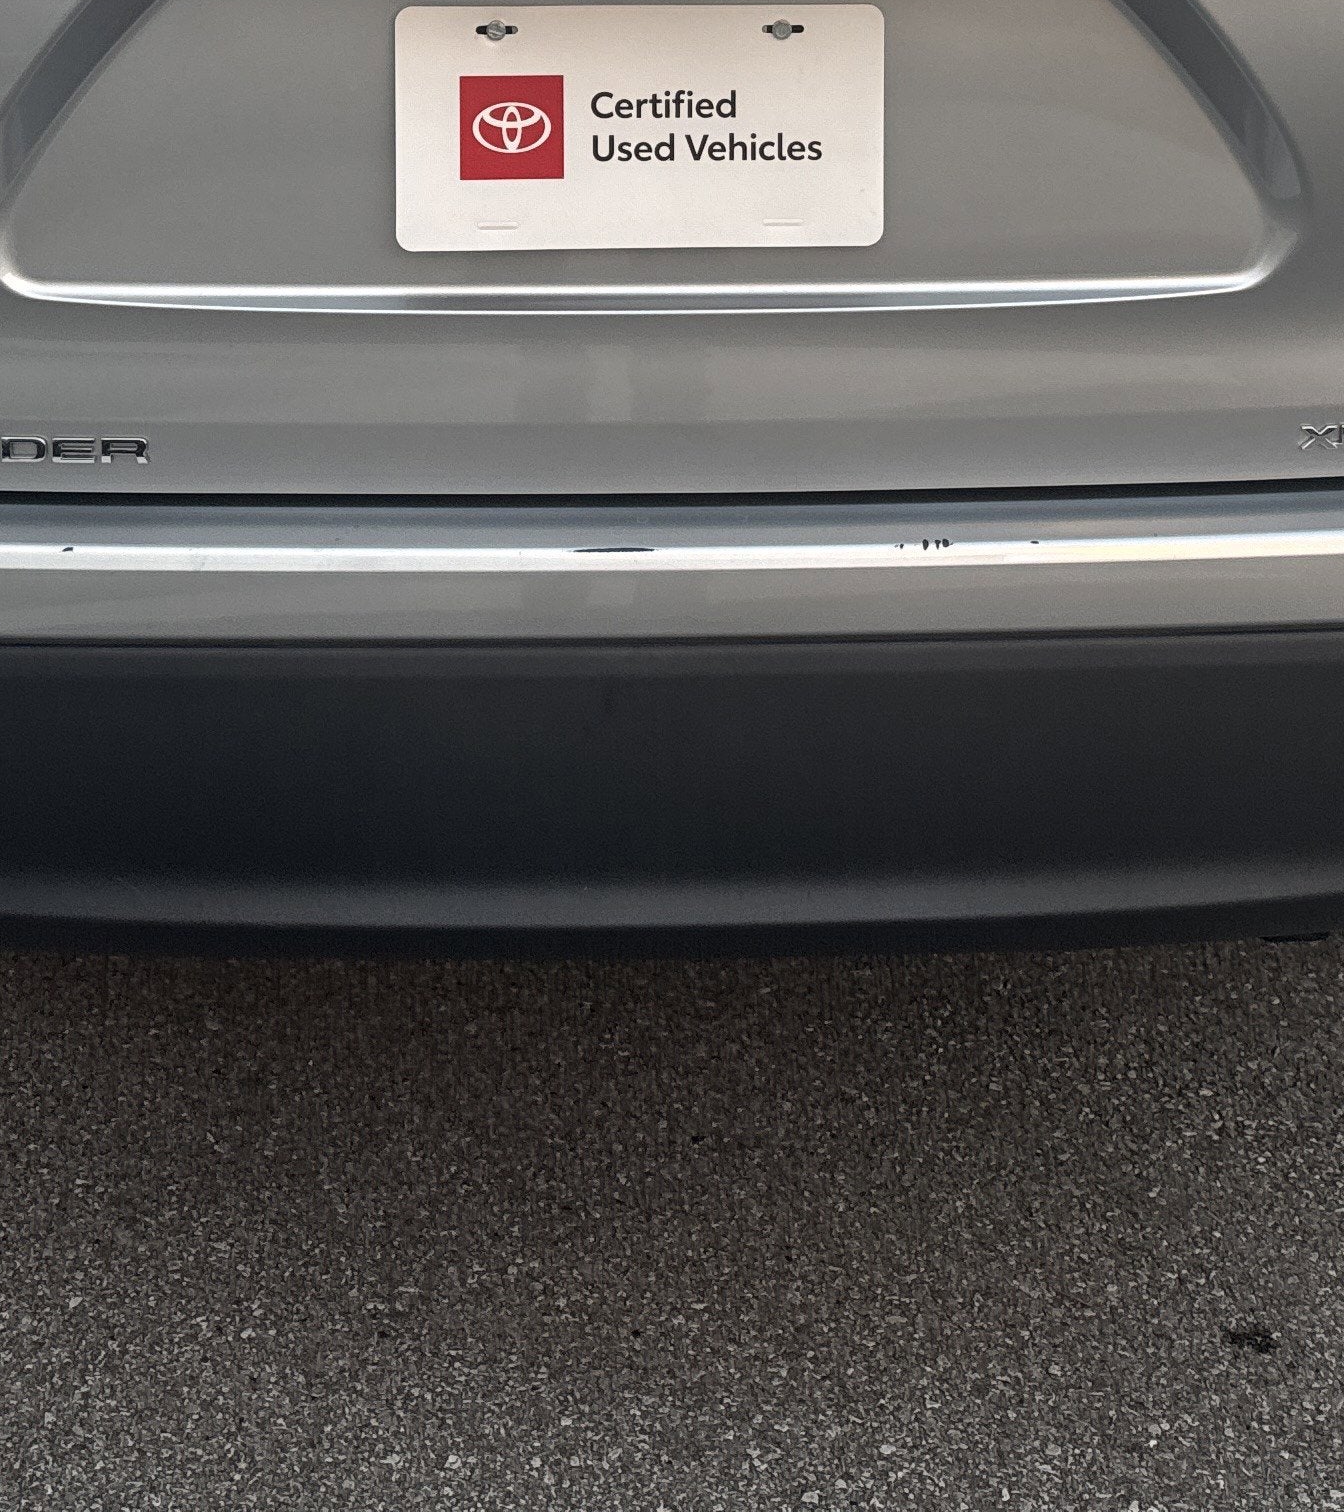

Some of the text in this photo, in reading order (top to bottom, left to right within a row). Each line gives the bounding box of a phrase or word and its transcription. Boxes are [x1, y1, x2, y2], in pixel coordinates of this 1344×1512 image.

[590, 90, 737, 119] Certified
[592, 133, 823, 162] Used Vehicles
